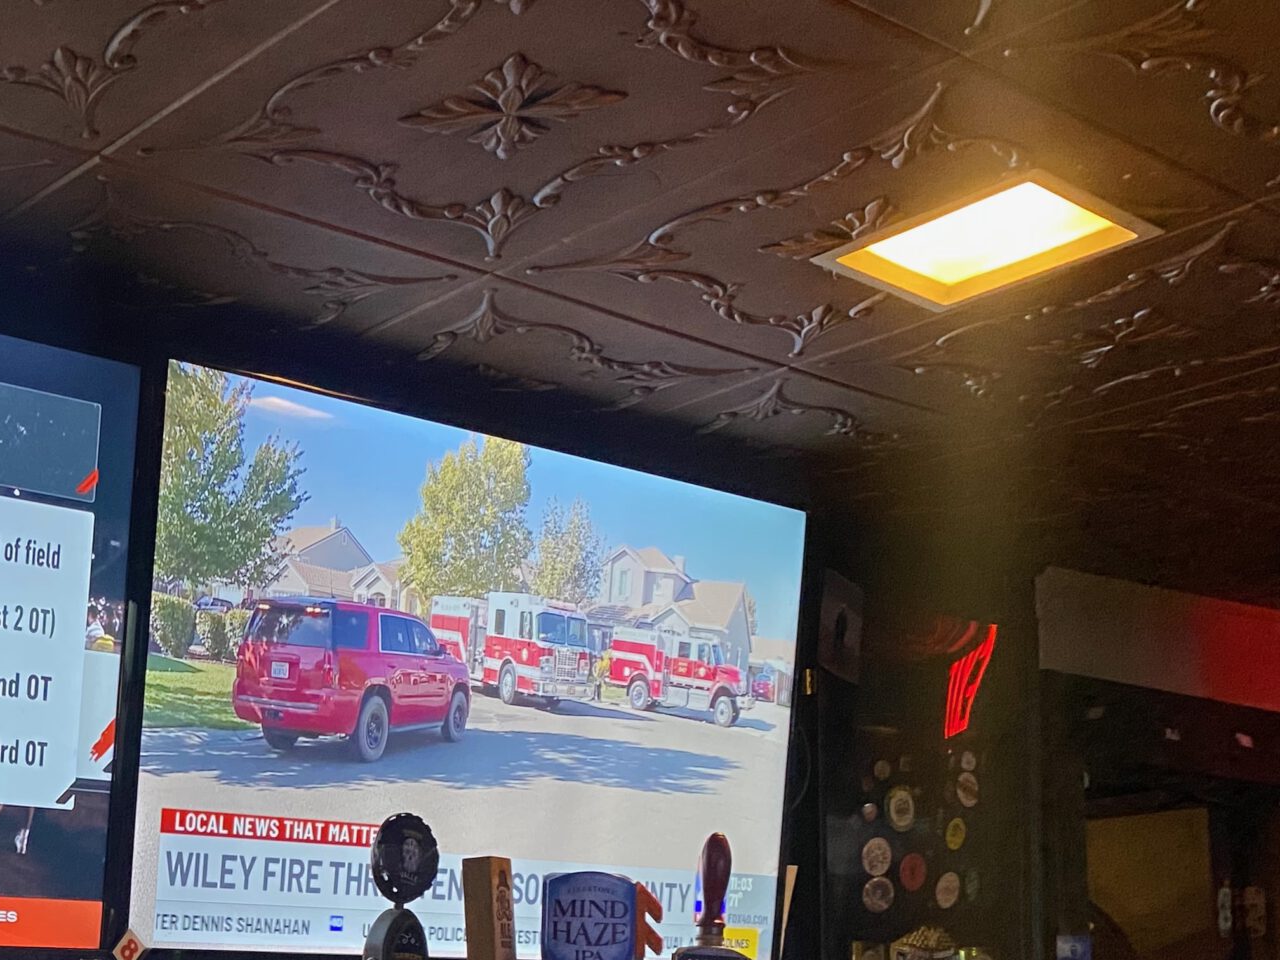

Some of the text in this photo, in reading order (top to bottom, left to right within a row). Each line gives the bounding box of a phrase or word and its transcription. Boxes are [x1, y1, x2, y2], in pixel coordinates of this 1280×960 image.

[4, 538, 21, 563] of
[25, 540, 61, 569] field
[13, 605, 23, 631] 2
[29, 607, 56, 638] OT)
[26, 674, 52, 701] OT
[25, 741, 48, 766] OT
[175, 811, 378, 843] LOCAL NEWS THAT MATTE
[166, 850, 323, 893] WILEY FIRE
[553, 899, 629, 919] MIND
[183, 915, 232, 933] DENNIS
[236, 916, 310, 936] SHANAHAN
[428, 926, 467, 943] POLIC
[552, 921, 628, 947] HAZE
